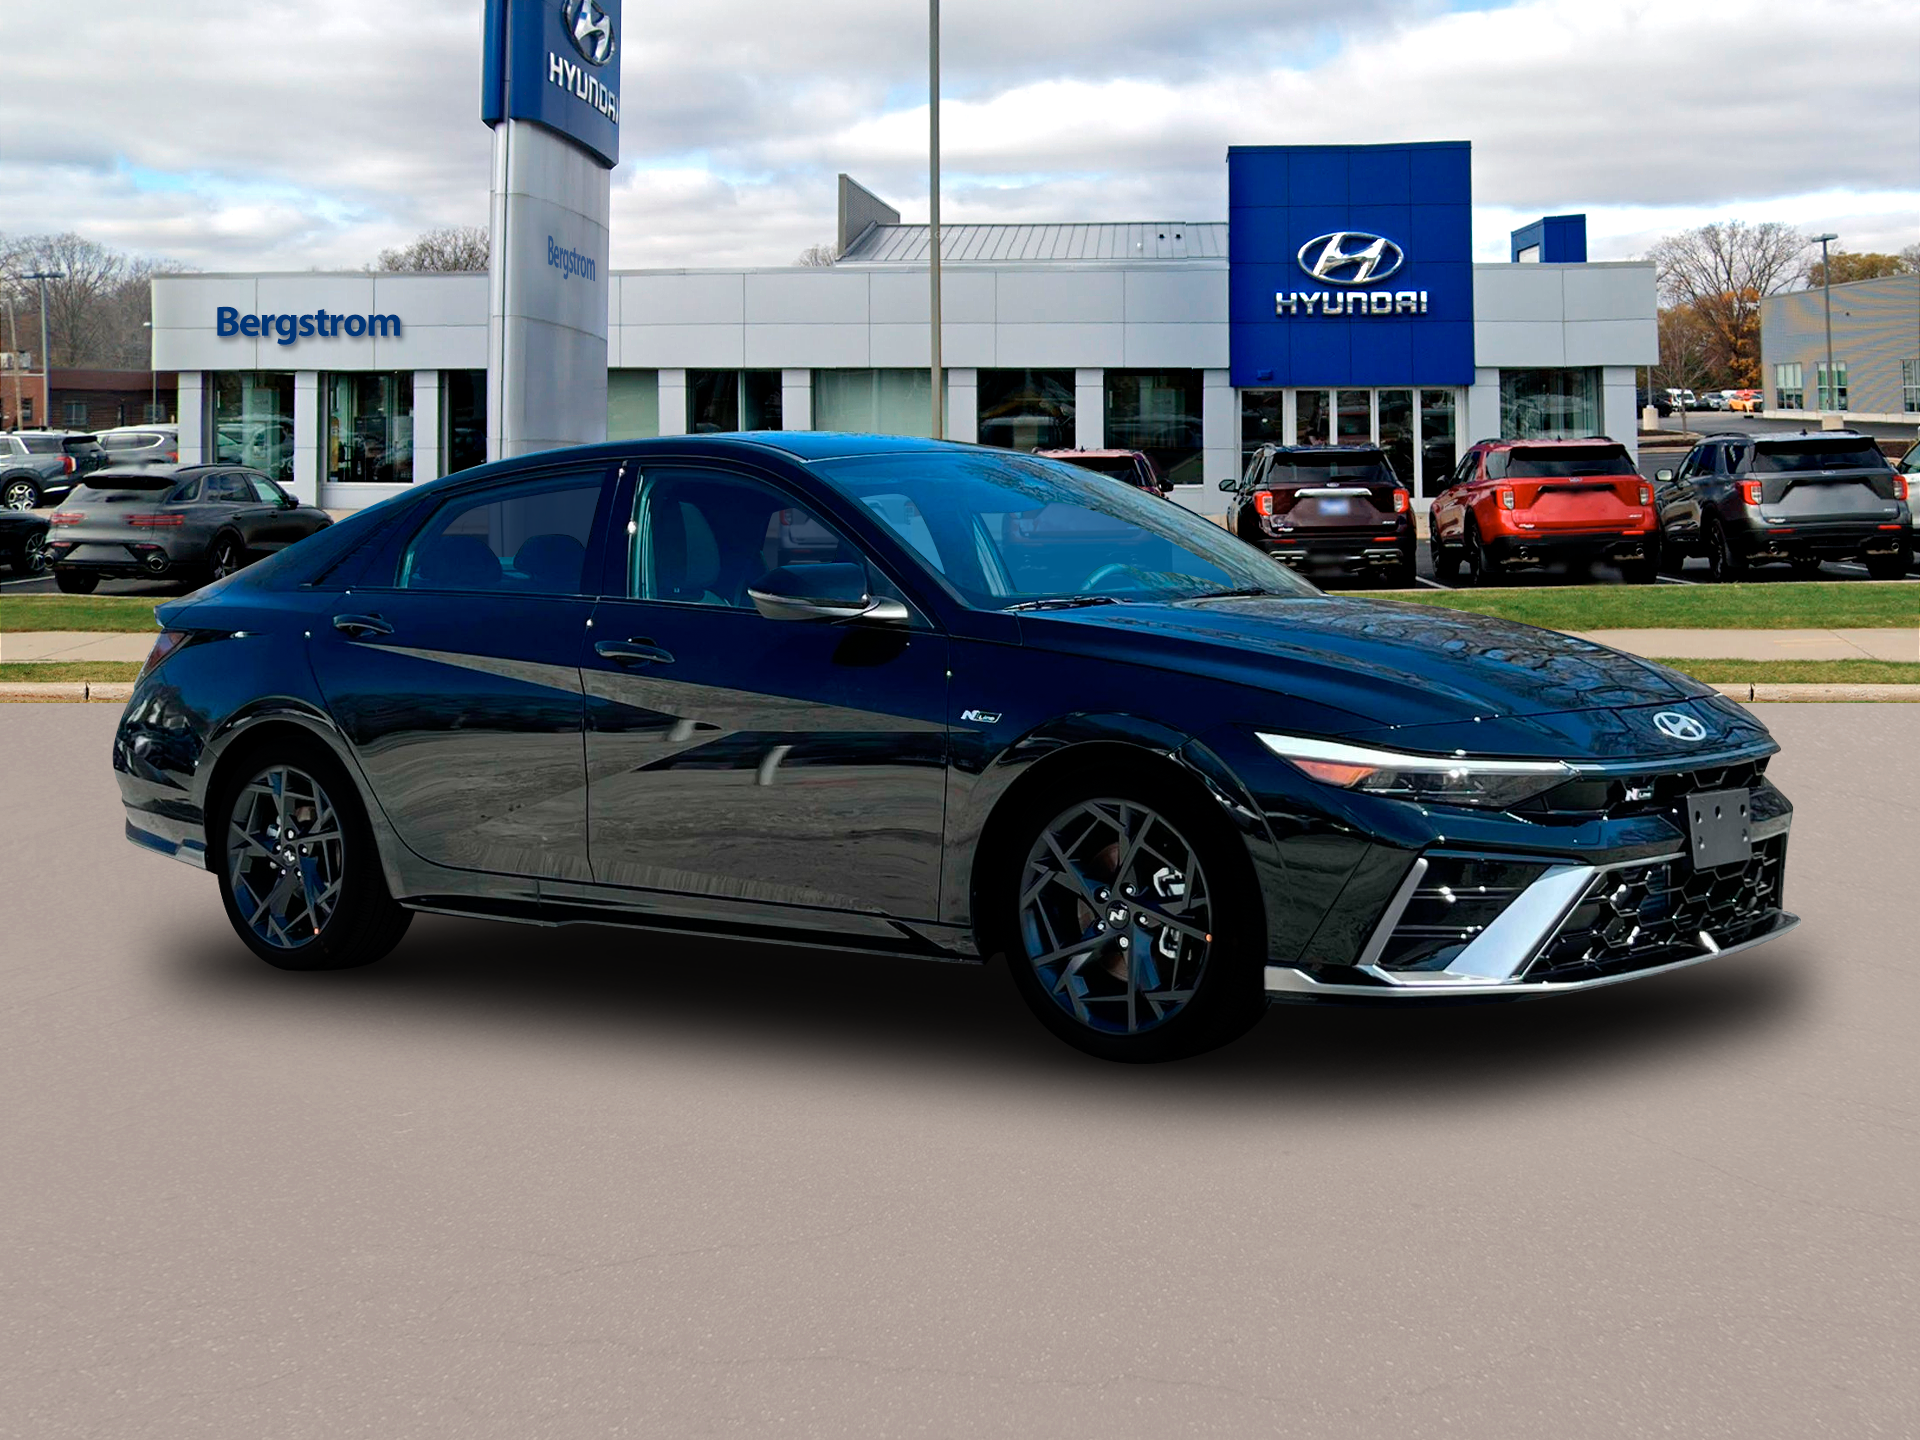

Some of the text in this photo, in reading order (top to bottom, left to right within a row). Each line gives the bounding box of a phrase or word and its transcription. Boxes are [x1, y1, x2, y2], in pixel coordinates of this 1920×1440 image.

[549, 52, 619, 124] HYUNDAI
[548, 235, 596, 282] Bergstrom
[1275, 291, 1428, 315] HYUNDAI
[216, 306, 401, 346] Bergstrom
